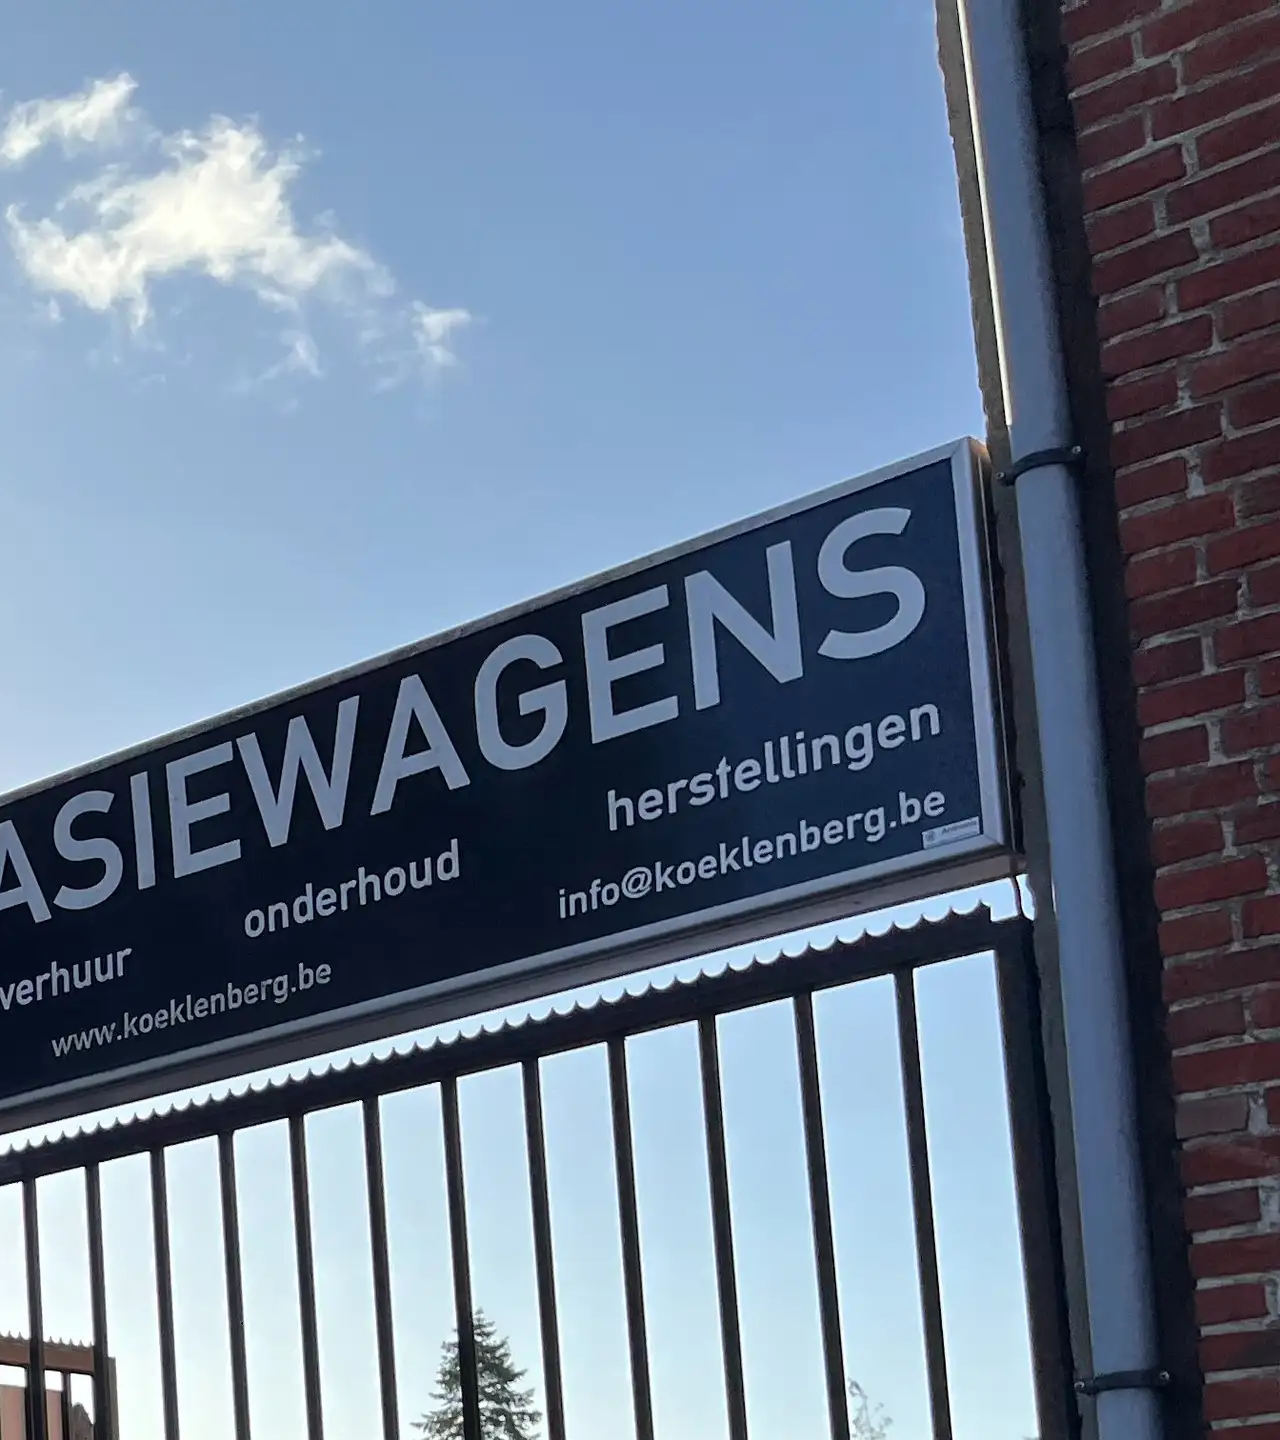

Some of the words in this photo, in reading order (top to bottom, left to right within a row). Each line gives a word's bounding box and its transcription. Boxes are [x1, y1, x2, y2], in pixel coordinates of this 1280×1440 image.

[607, 702, 941, 831] herstellingen
[244, 838, 460, 938] onderhoud
[558, 790, 945, 919] info@koeklenberg.be
[51, 961, 332, 1057] www.koeklenberg.be
